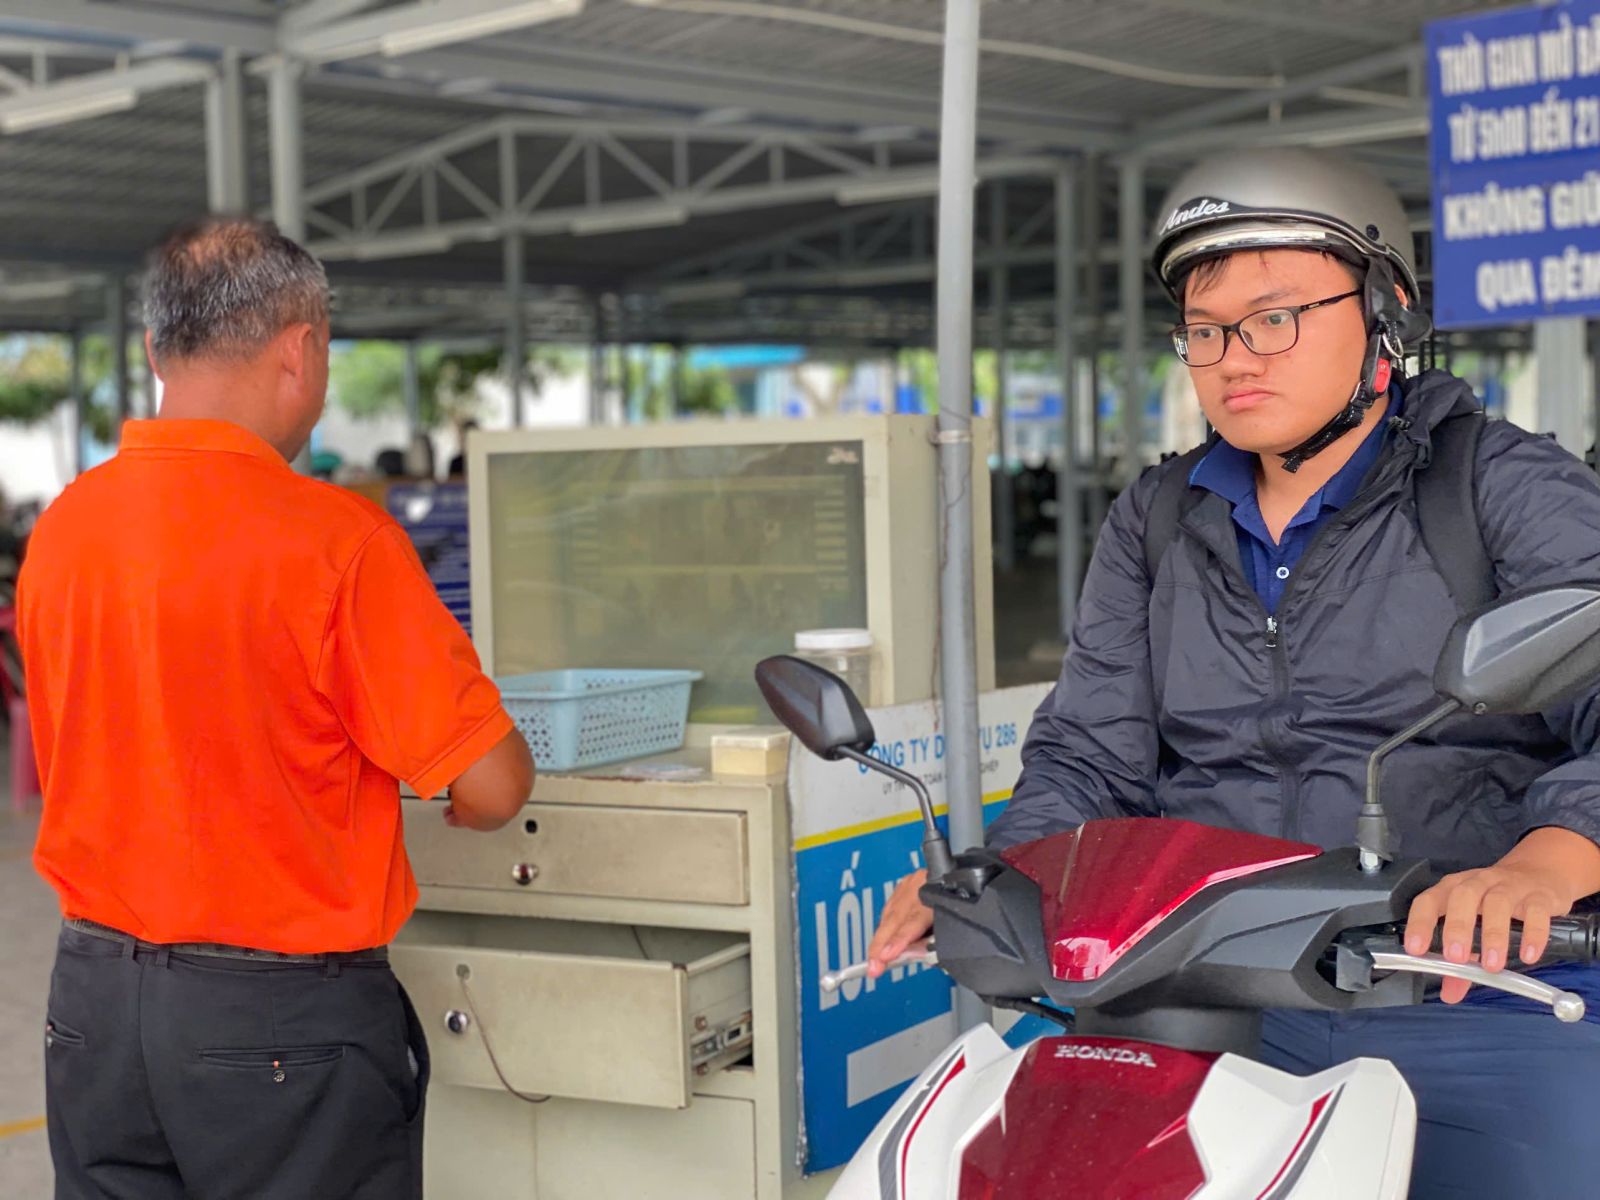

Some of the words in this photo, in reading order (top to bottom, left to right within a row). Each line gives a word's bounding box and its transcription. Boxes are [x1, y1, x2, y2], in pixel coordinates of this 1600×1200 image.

[1159, 199, 1230, 236] Andes
[1443, 181, 1546, 241] KHÔNG
[1476, 258, 1538, 313] QUA
[910, 737, 930, 763] TY
[995, 723, 1017, 747] 286
[815, 851, 875, 1011] LỐI
[1054, 1044, 1157, 1068] HONDA
